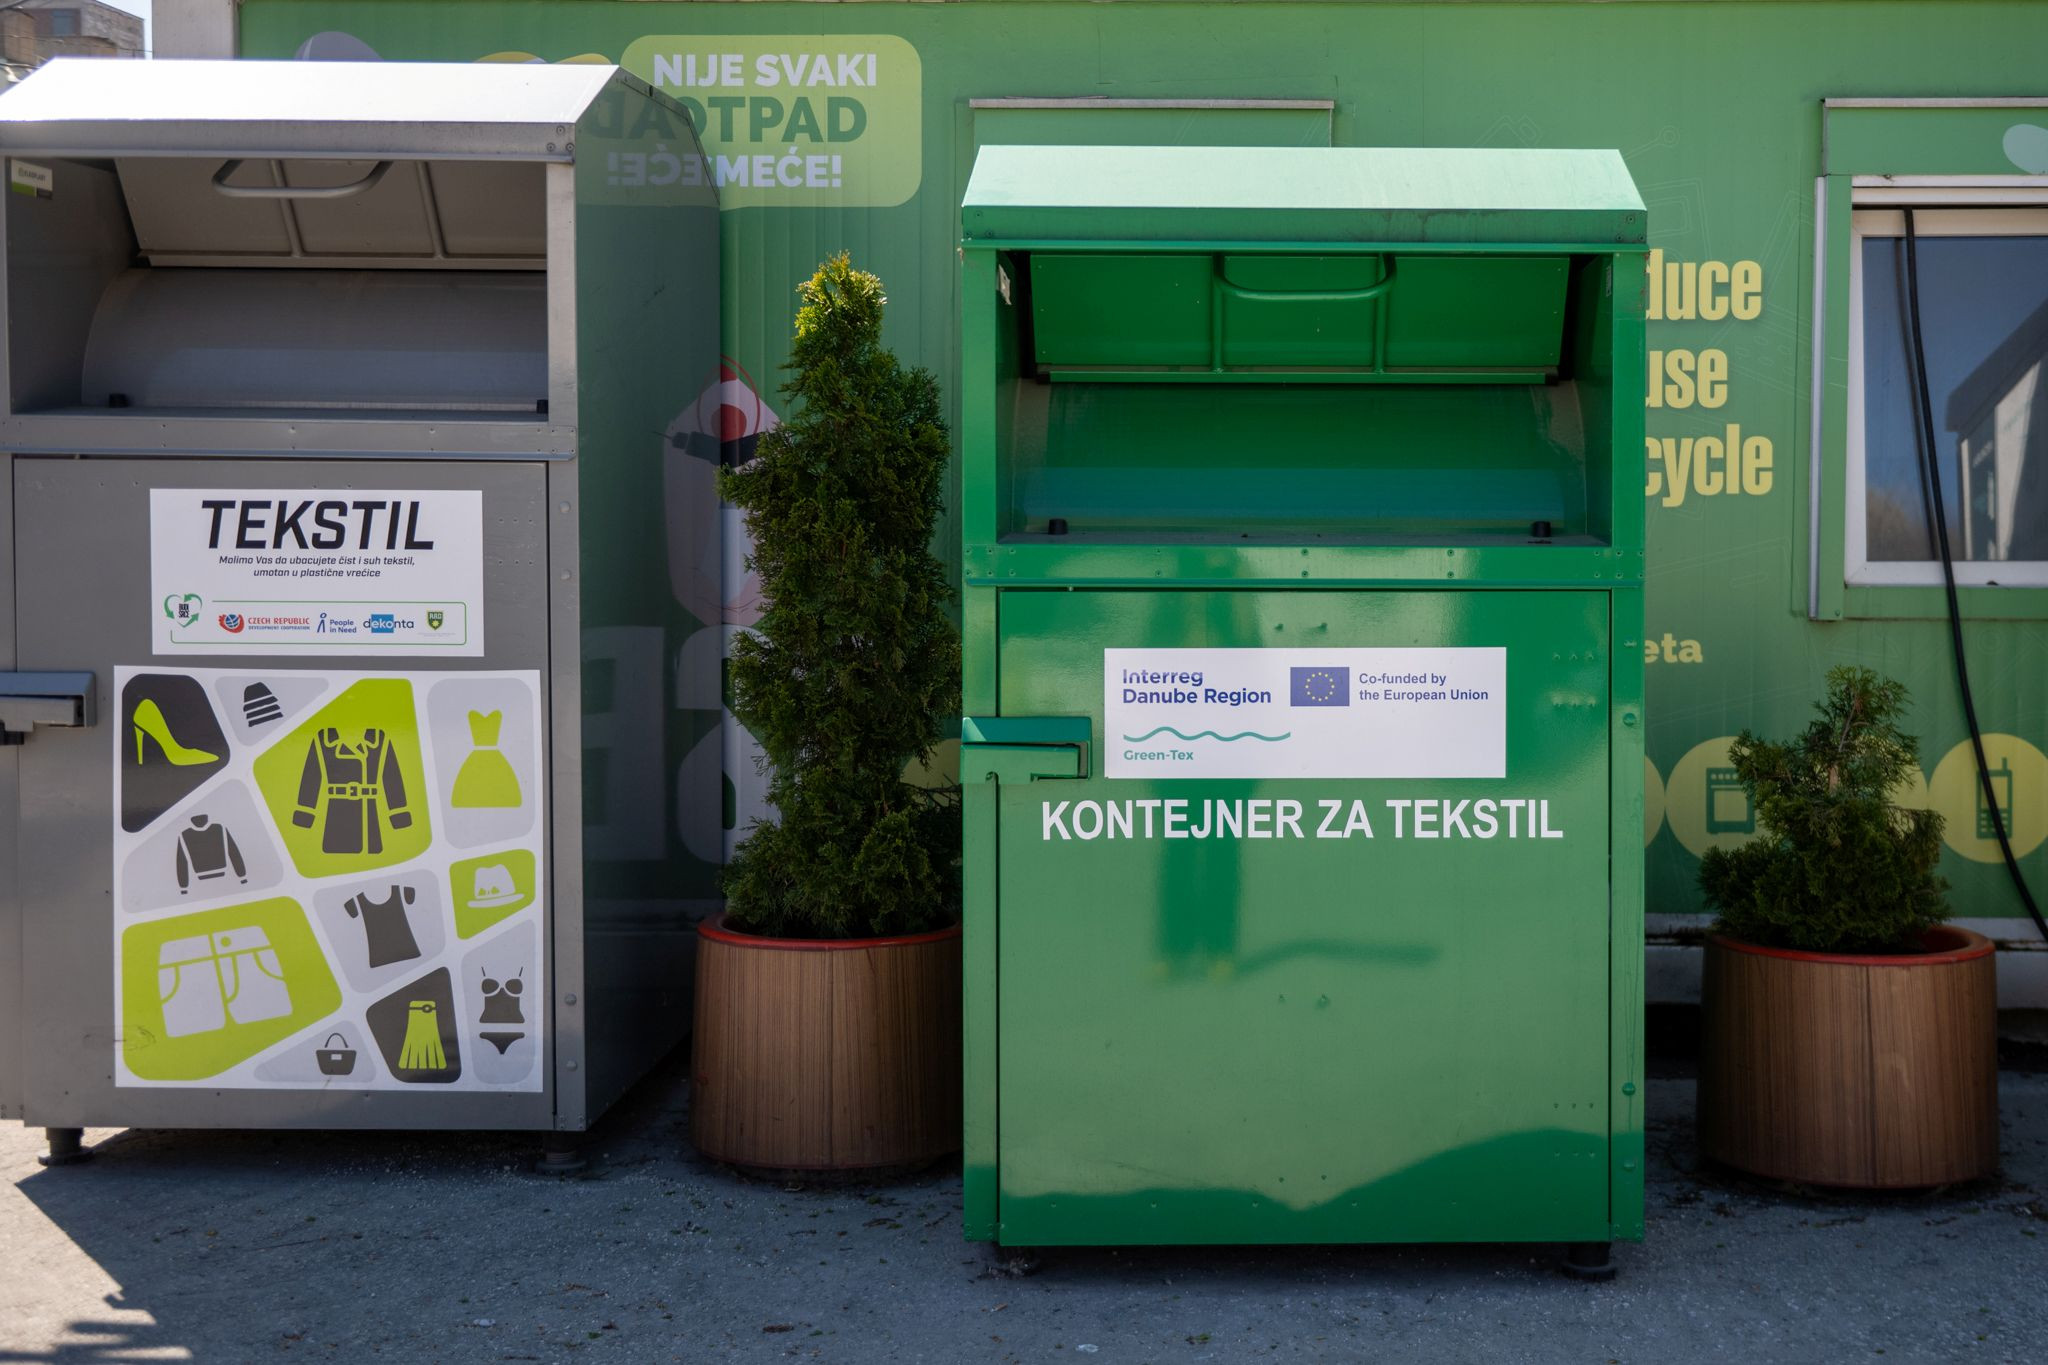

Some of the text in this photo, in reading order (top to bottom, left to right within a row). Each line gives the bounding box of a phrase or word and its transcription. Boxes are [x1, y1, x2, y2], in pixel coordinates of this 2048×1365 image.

[654, 54, 877, 87] NIJE SVAKI
[708, 147, 841, 188] MEĆE!
[202, 500, 434, 550] TEKSTIL
[219, 556, 253, 565] Molimo
[256, 556, 273, 565] Vas
[275, 556, 287, 565] da
[290, 556, 336, 566] ubacujete
[338, 556, 356, 565] čist
[363, 556, 381, 565] suh
[383, 556, 415, 567] tekstil,
[253, 569, 290, 578] umotan
[300, 568, 344, 579] plastične
[346, 568, 381, 578] vrećice
[248, 617, 310, 625] CZECH REPUBLIC
[329, 619, 355, 627] People
[363, 618, 415, 630] dekonta
[338, 626, 357, 634] Need
[1122, 669, 1204, 687] Interreg
[1359, 673, 1447, 686] Co-funded by
[1122, 688, 1272, 706] Danube Region
[1359, 689, 1489, 702] the European Union
[1123, 750, 1194, 761] Green-Tex
[1042, 799, 1563, 841] KONTEJNER ZA TEKSTIL
